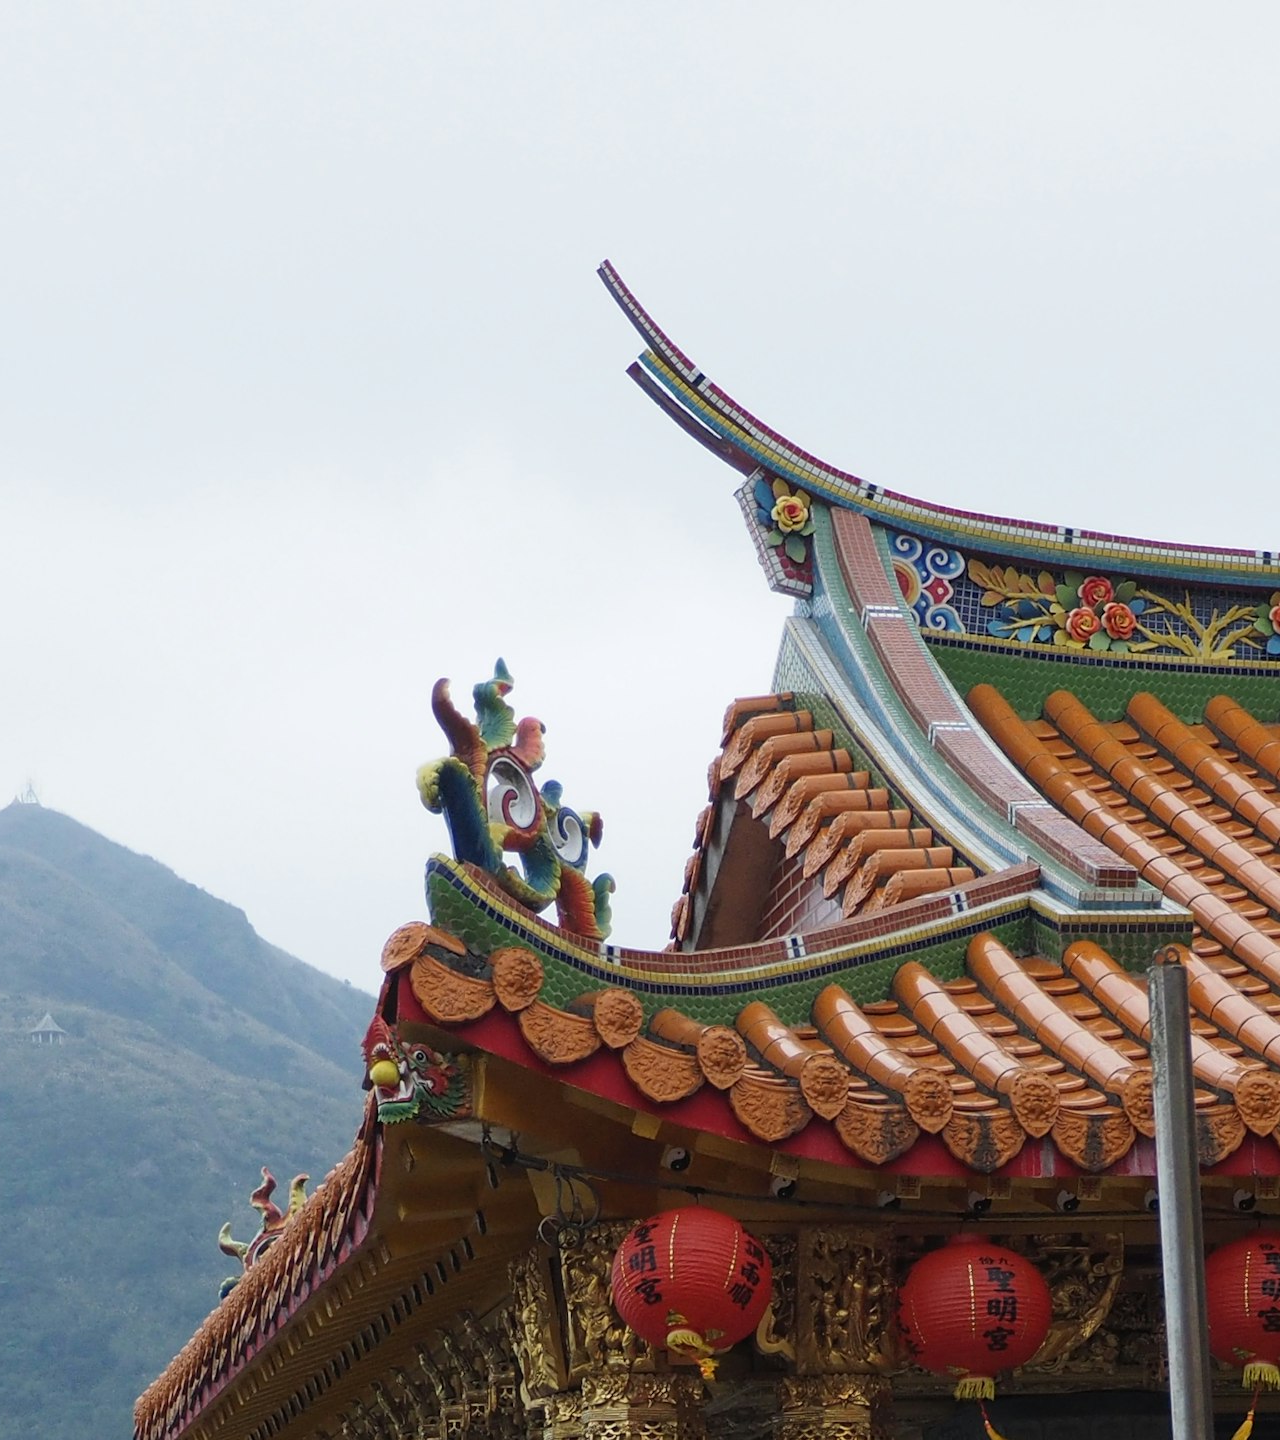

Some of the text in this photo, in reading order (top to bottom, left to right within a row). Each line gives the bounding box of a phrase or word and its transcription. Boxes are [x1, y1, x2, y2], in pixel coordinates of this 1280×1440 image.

[629, 1223, 663, 1306] 聖明宮
[983, 1266, 1017, 1351] 聖明宮
